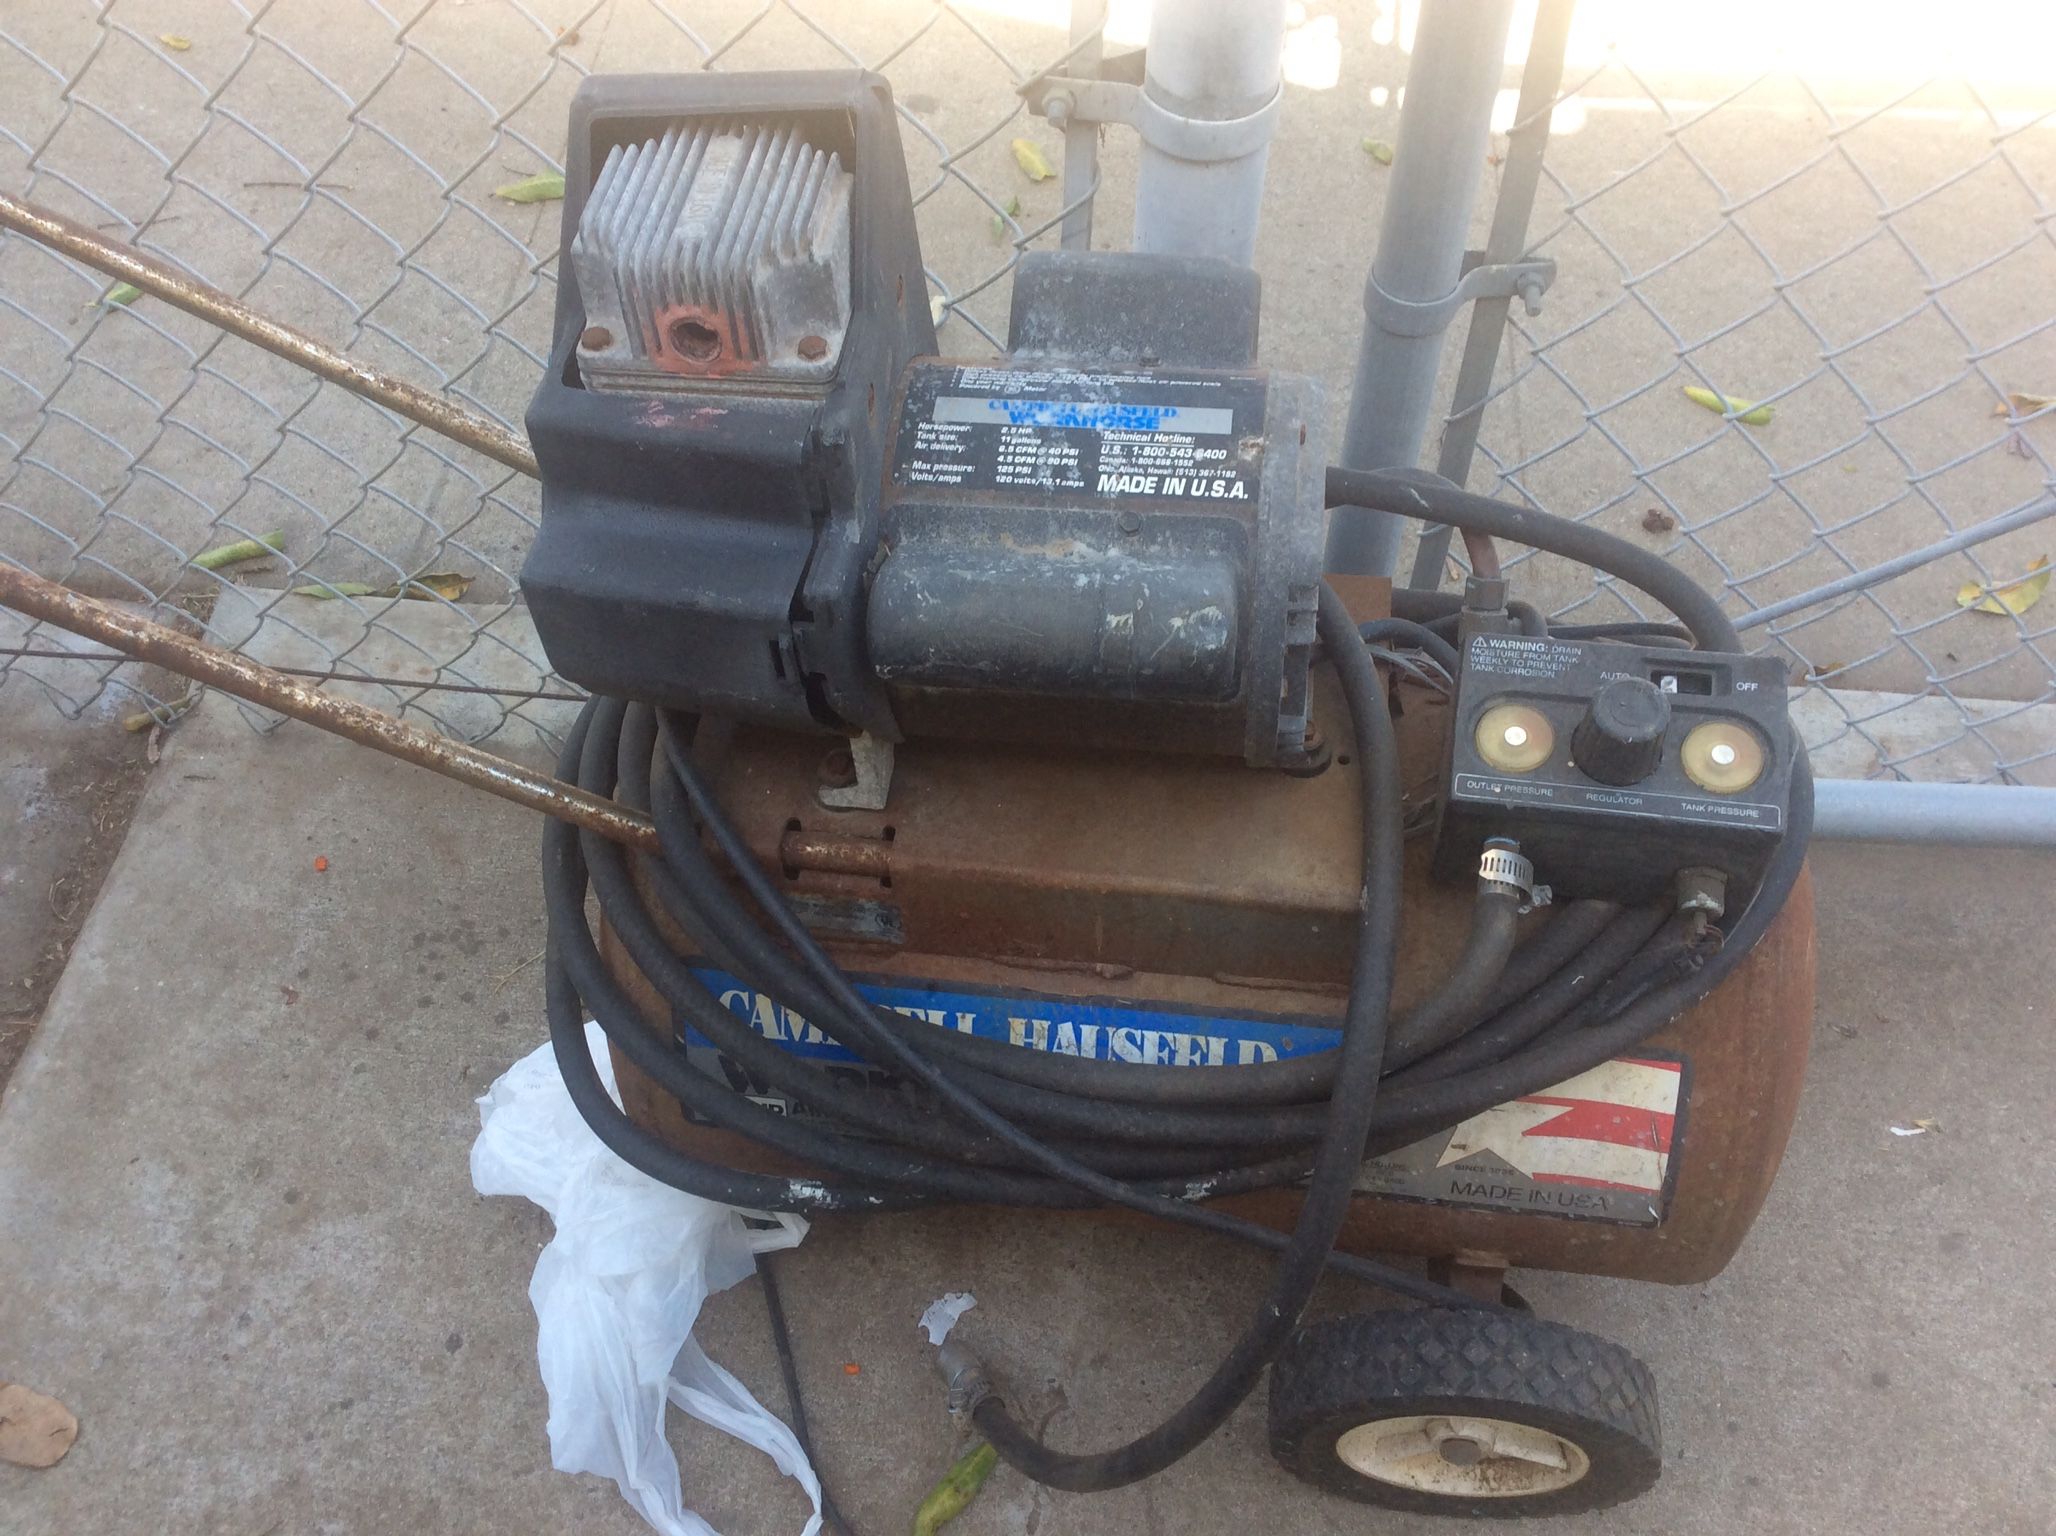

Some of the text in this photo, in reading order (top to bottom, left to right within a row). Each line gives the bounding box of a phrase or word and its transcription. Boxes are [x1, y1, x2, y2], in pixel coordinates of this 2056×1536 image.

[917, 422, 973, 432] Horsepower:
[916, 432, 937, 441] Tank
[1103, 431, 1152, 442] Technical
[914, 441, 928, 450] Air
[930, 443, 966, 453] delivery:
[1015, 446, 1036, 454] CFM
[1048, 447, 1062, 455] 40
[1062, 448, 1079, 456] PSI
[1101, 445, 1127, 455] U.S.:
[912, 461, 931, 470] Max
[932, 463, 976, 474] pressure:
[1015, 466, 1032, 474] PSI
[1014, 456, 1035, 465] CFM
[1061, 458, 1078, 467] PSI
[911, 471, 962, 485] Volts/amps
[1097, 474, 1249, 499] MADE IN U.S.A.
[1490, 639, 1582, 656] WARNING: DRAIN
[1472, 648, 1579, 664] MOISTURE FROM TANK
[1471, 656, 1570, 671] WEEKLY TO PREVENT
[1471, 663, 1555, 678] TANK CORROSION
[1736, 681, 1759, 691] OFF
[1467, 781, 1553, 797] OUTLET PRESSURE
[1586, 792, 1643, 806] REGULATOR
[1681, 802, 1759, 818] TANK PRESSURE
[1451, 1180, 1609, 1211] MADE IN USA
